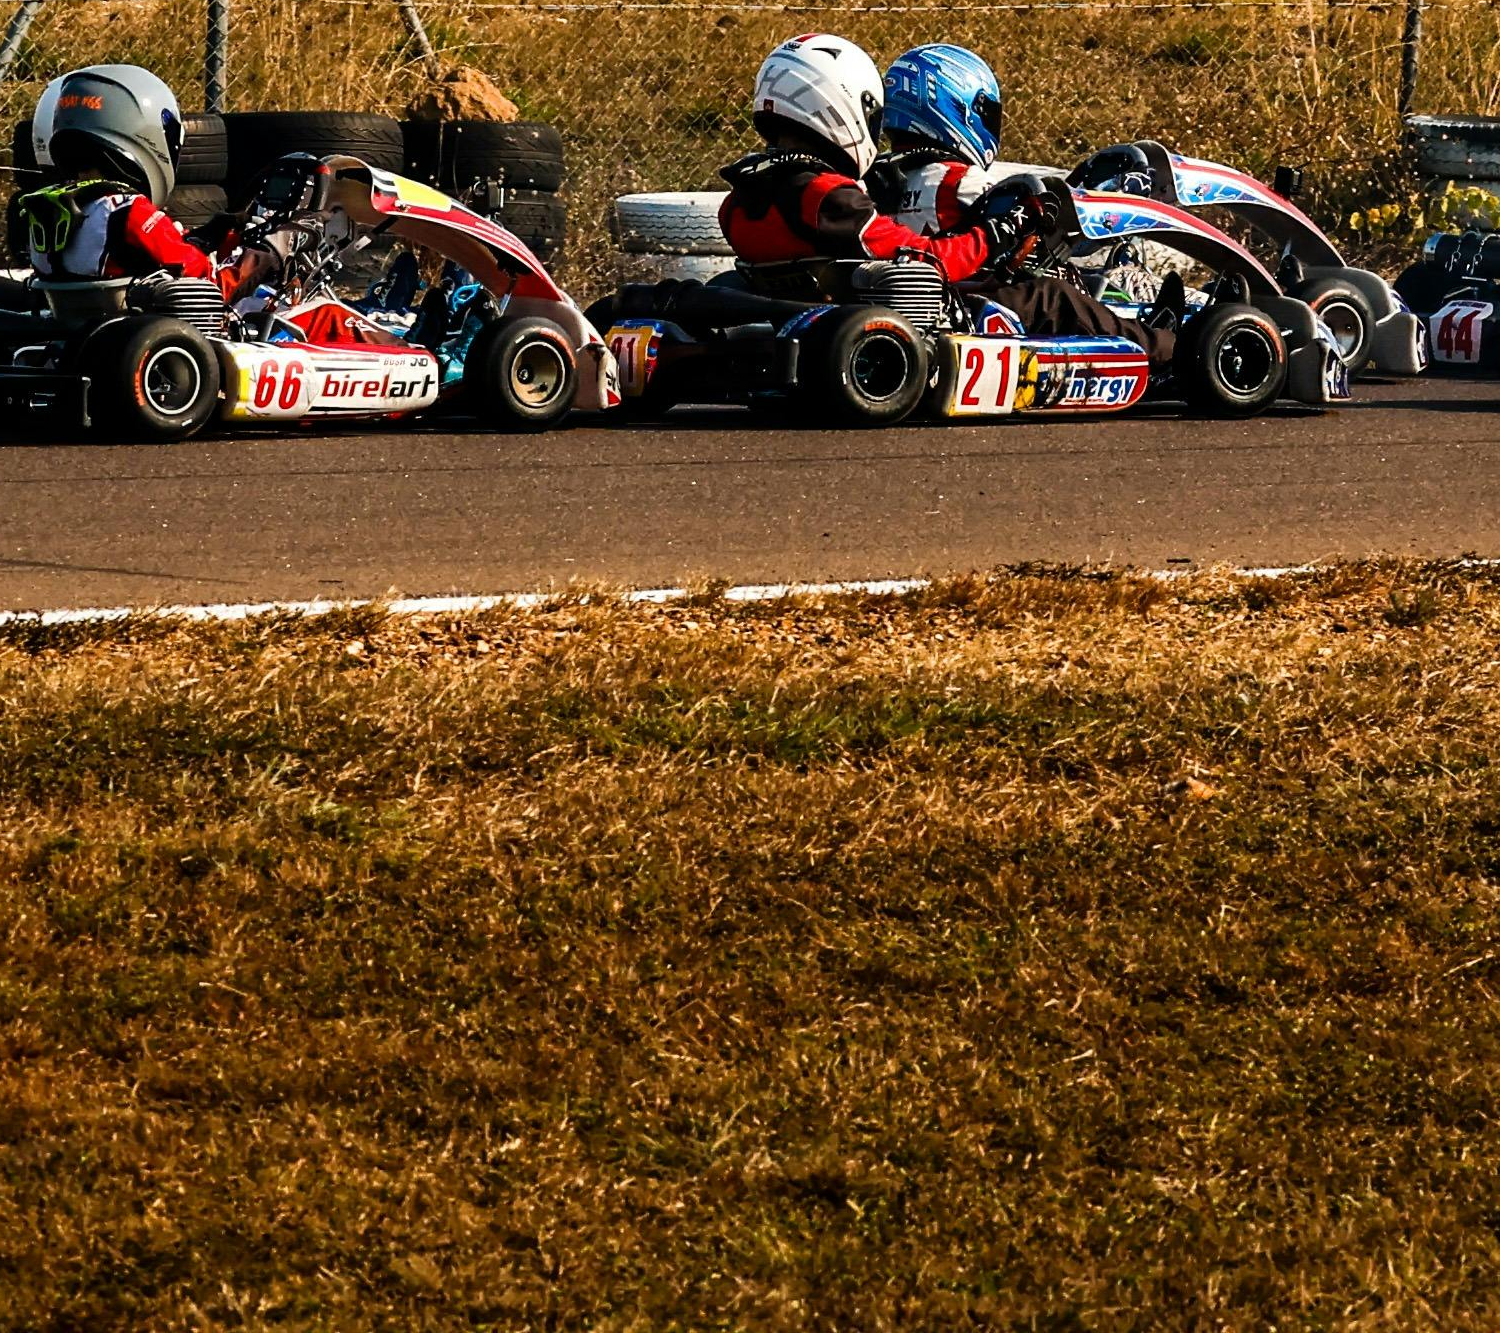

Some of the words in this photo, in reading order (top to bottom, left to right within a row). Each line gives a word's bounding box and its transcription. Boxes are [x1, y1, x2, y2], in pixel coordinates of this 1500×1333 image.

[1438, 308, 1480, 360] 44
[253, 358, 304, 410] 66
[321, 374, 436, 398] birelart
[961, 346, 1011, 407] 21
